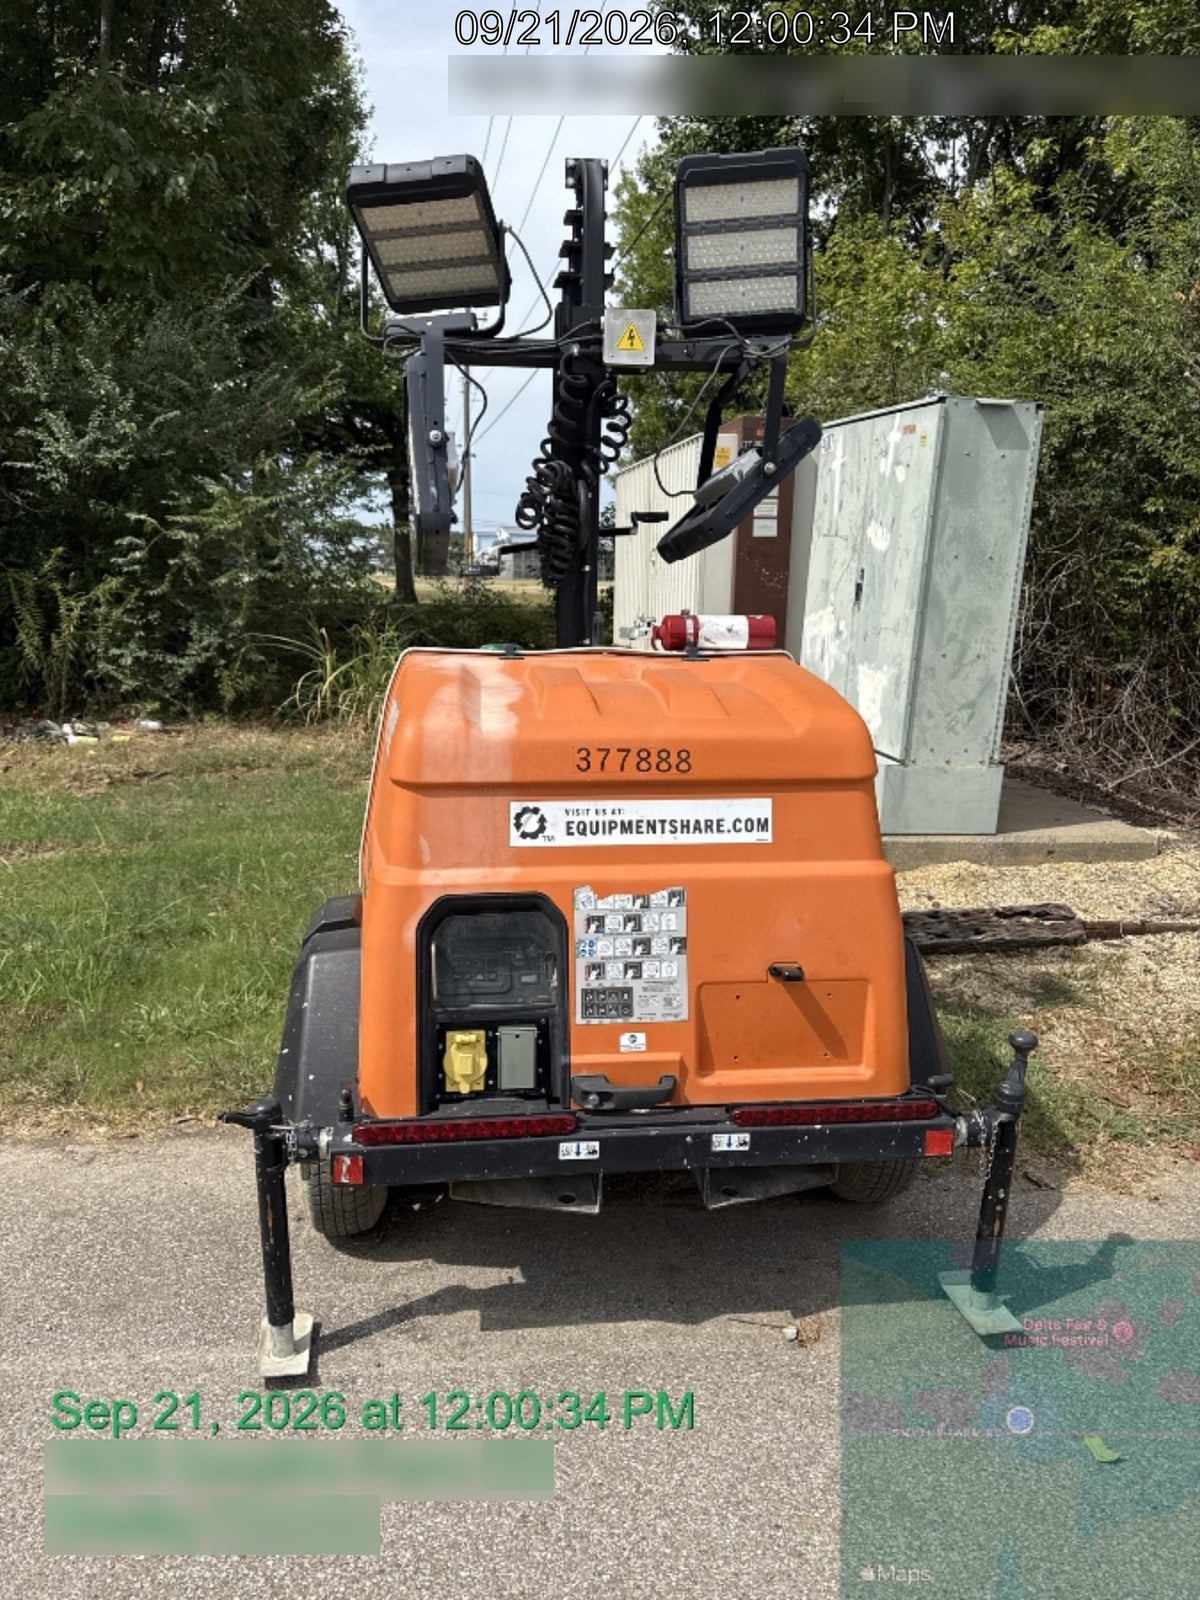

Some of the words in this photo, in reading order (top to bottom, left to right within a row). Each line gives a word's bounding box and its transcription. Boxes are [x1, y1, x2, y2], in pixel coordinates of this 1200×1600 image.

[575, 747, 692, 773] 377888
[565, 808, 591, 817] VISIT
[595, 808, 607, 816] US
[611, 808, 626, 816] AT:
[565, 817, 769, 838] EQUIPMENTSHARE.COM
